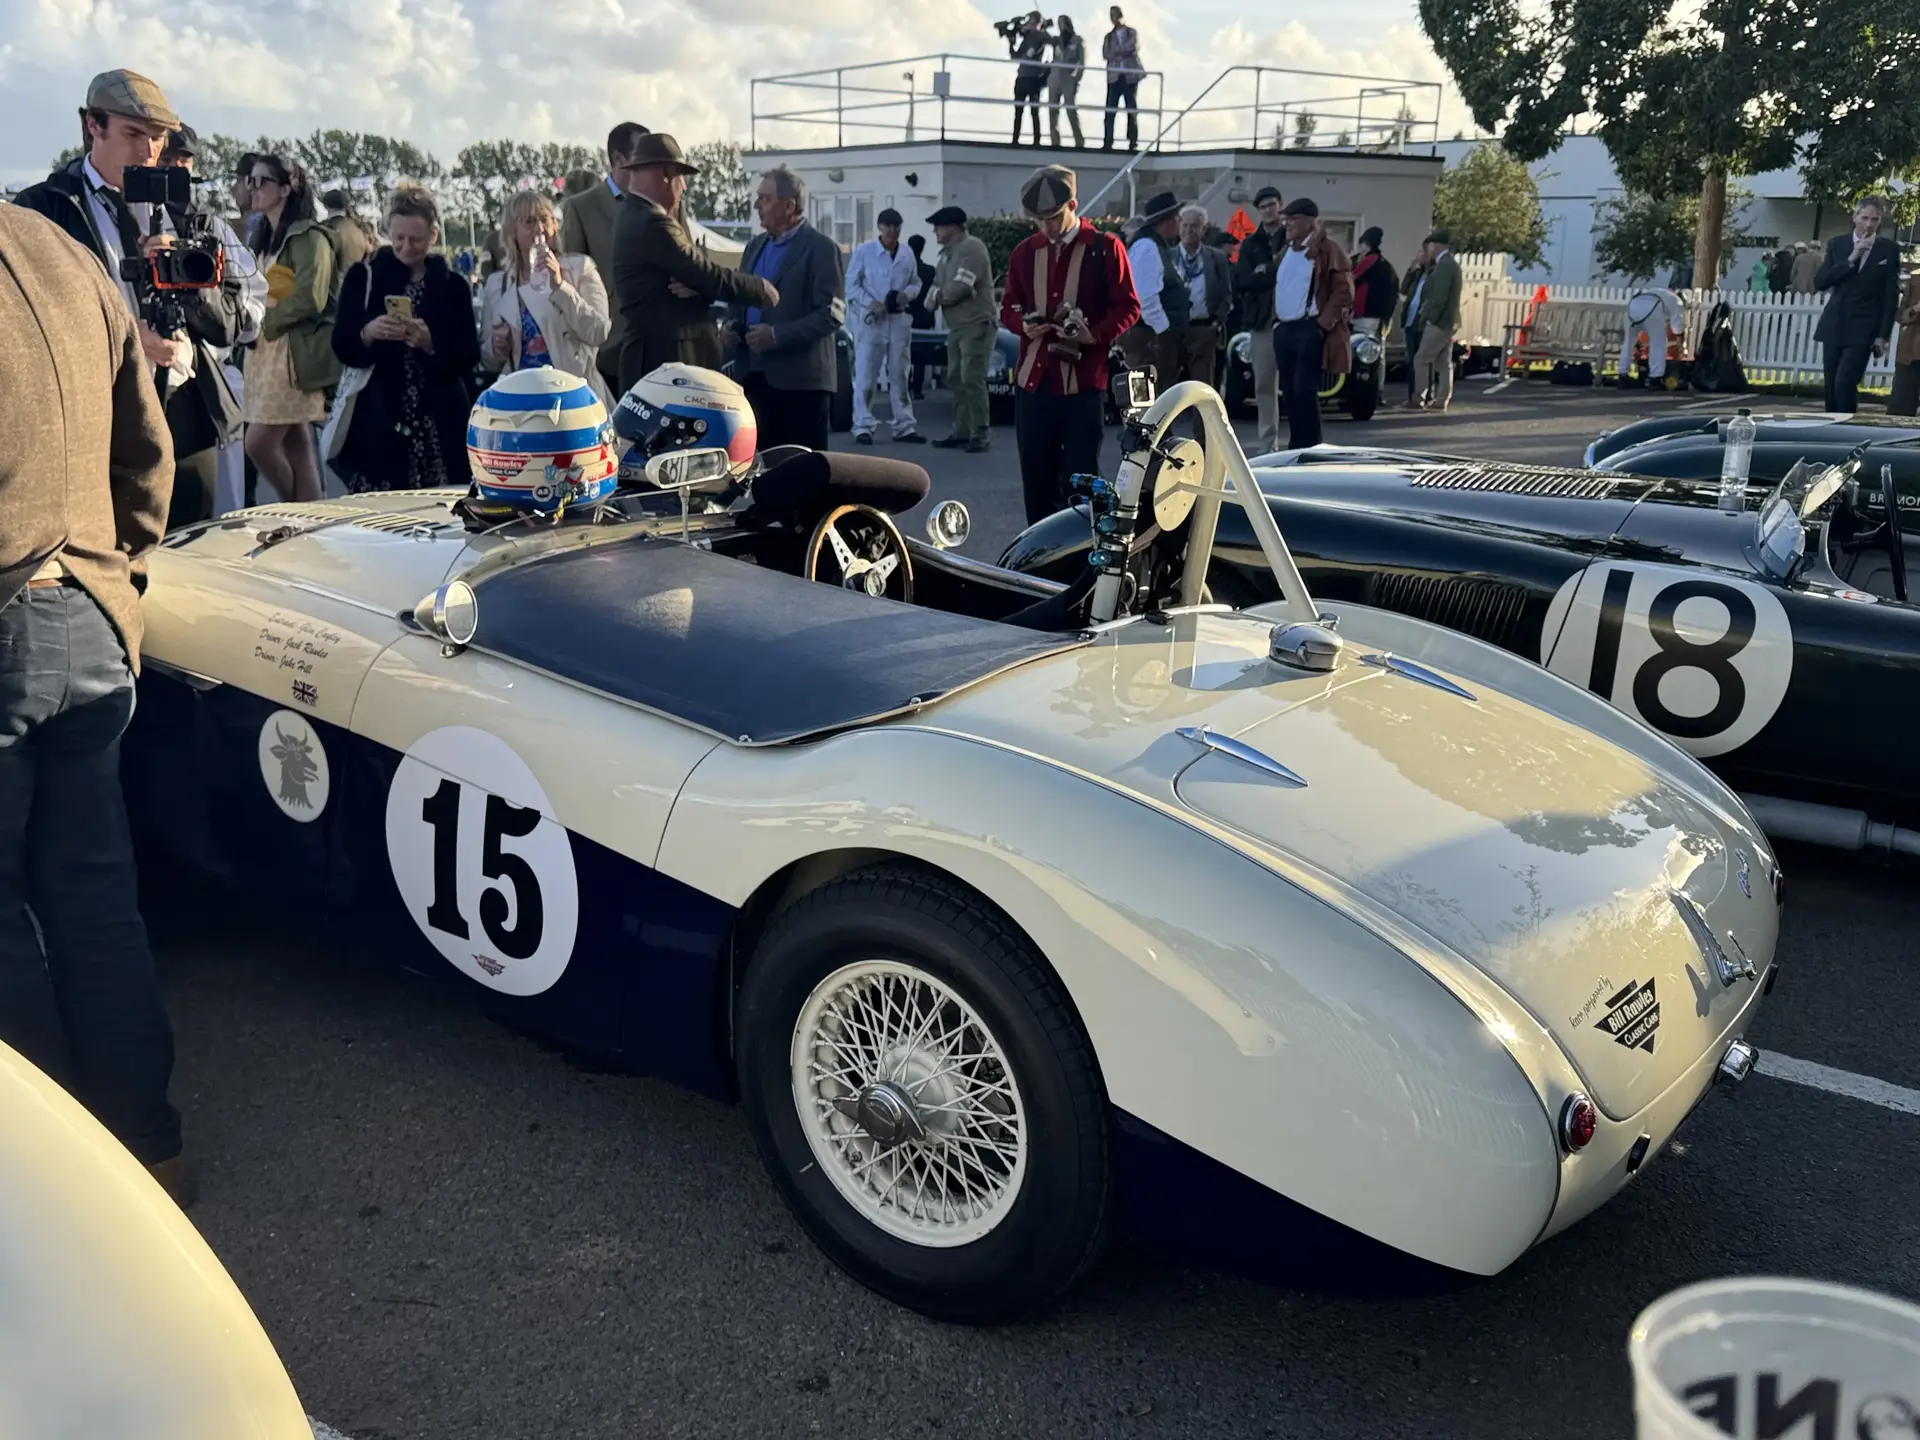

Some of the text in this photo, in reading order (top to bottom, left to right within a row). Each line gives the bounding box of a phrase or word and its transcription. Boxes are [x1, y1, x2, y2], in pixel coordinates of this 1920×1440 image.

[297, 659, 313, 674] Hill
[1588, 568, 1757, 739] 18
[422, 778, 542, 960] 15
[1607, 988, 1654, 1033] Bill Rawles
